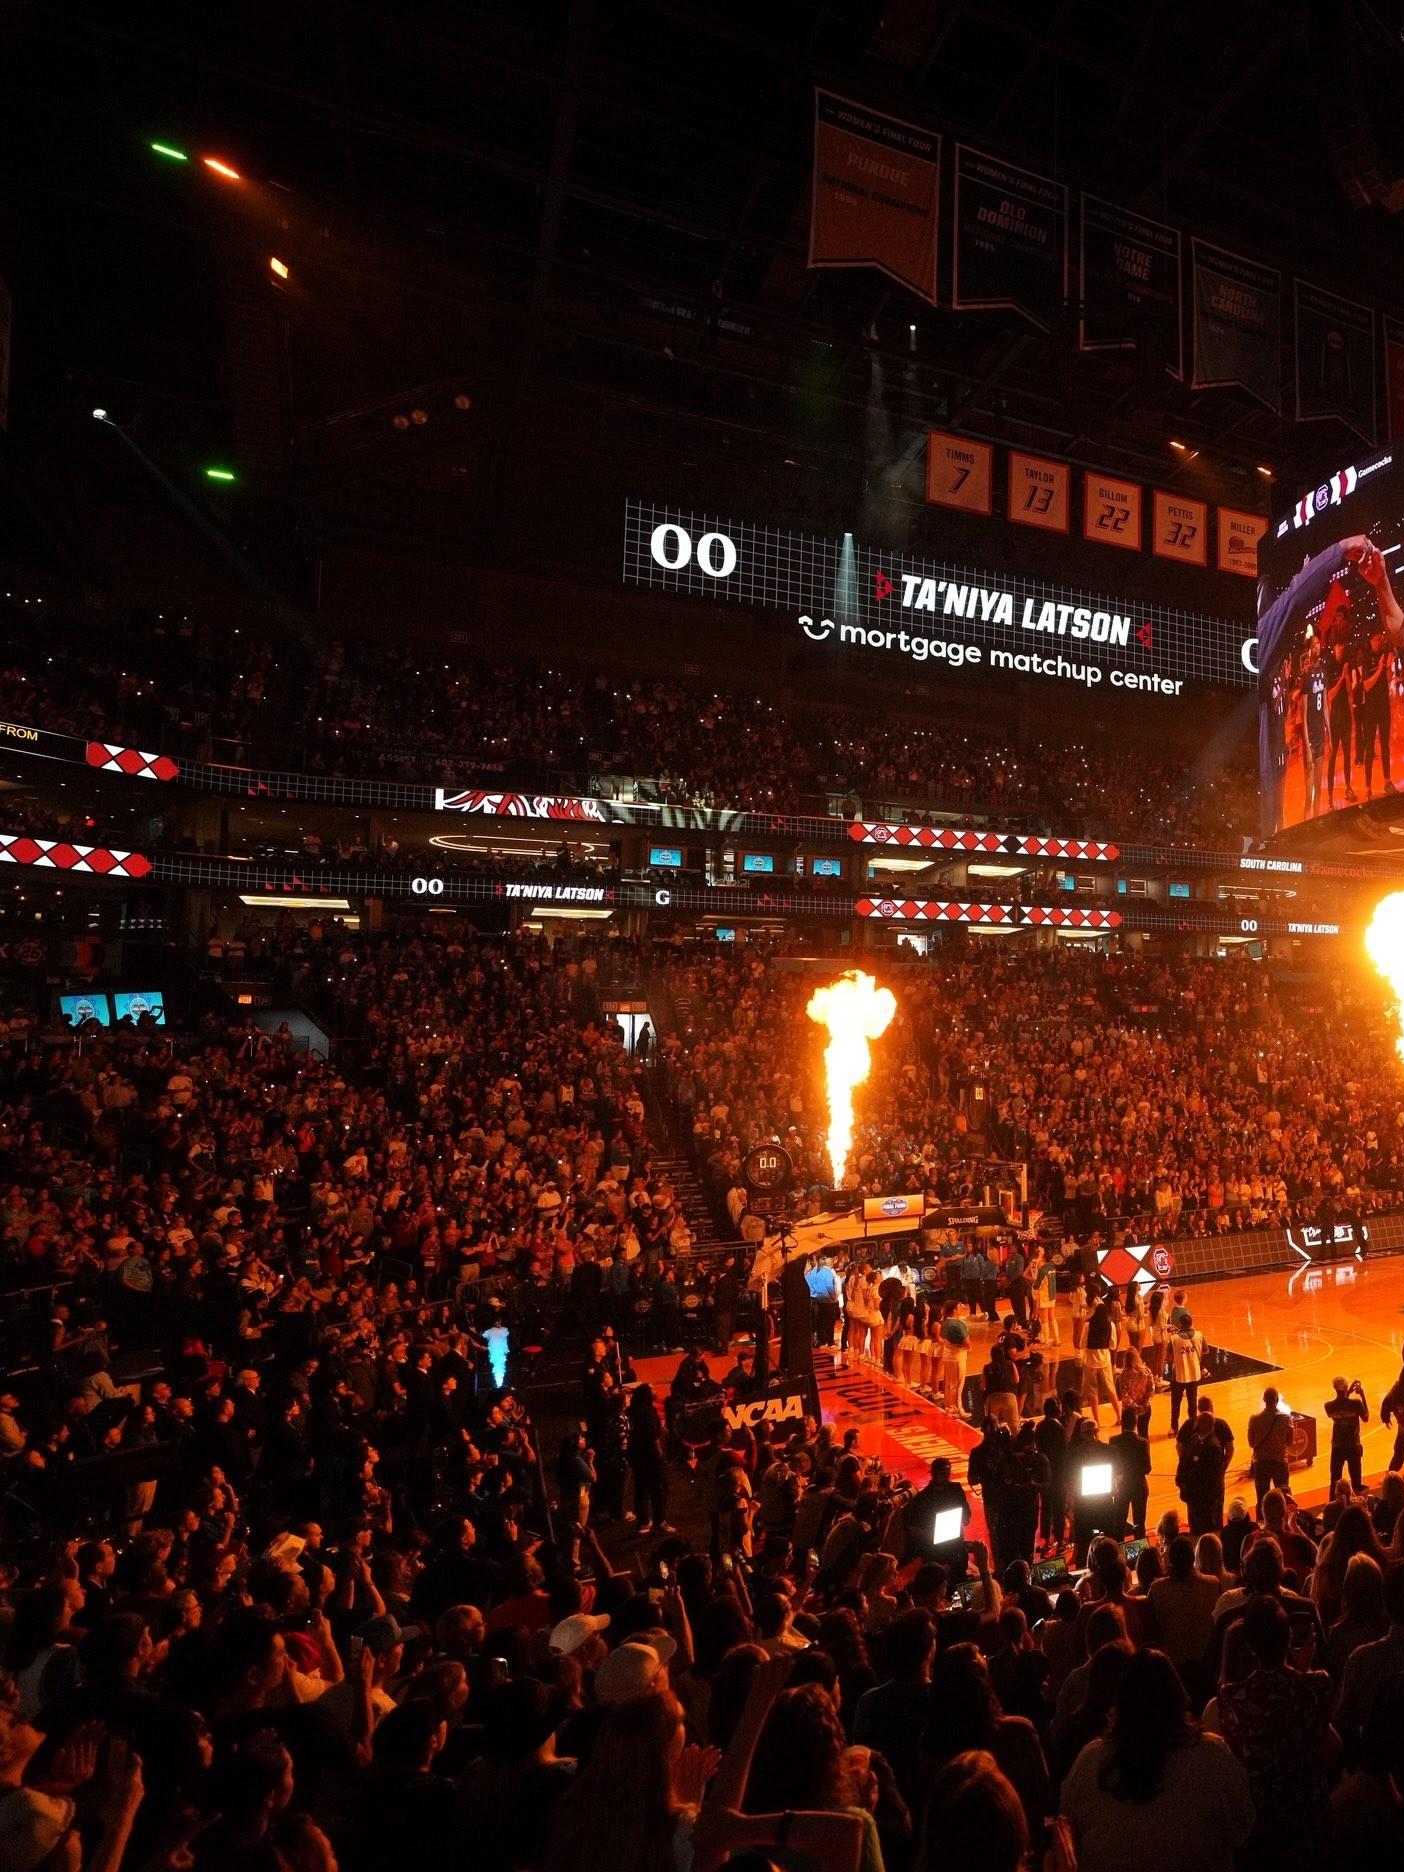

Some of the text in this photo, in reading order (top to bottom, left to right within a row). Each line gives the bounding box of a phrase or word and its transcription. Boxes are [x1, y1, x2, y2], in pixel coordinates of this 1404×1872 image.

[837, 110, 932, 152] WOMEN'S FINAL FOUR
[846, 152, 911, 187] PURDUE
[1000, 200, 1027, 221] OLD
[976, 205, 1049, 244] DOMINION
[1113, 241, 1153, 267] NOTRE
[1115, 256, 1149, 281] DAME
[1218, 283, 1257, 307] NORTH
[945, 447, 976, 465] TIMMS
[948, 466, 971, 495] 7
[1024, 467, 1055, 485] TAYLOR
[1023, 484, 1055, 515] 13
[1098, 487, 1128, 504] GILLOM
[1095, 503, 1130, 533] 22
[1168, 505, 1194, 521] PETTIS
[1164, 521, 1197, 549] 32
[1230, 521, 1256, 536] MILLER
[650, 523, 737, 578] 00
[900, 573, 1131, 647] TA'NIYA LATSON
[839, 622, 1184, 696] mortgage matchup center
[1316, 693, 1322, 711] 8
[0, 724, 39, 742] FROM
[1239, 858, 1265, 870] SOUTH
[1266, 859, 1302, 873] CAROLINA
[412, 878, 671, 906] 00 TA'NIYA LATSON G
[1241, 919, 1258, 932] 00
[1313, 923, 1340, 935] LATSON
[760, 1157, 777, 1168] 0.0
[947, 1215, 979, 1226] SPALDING
